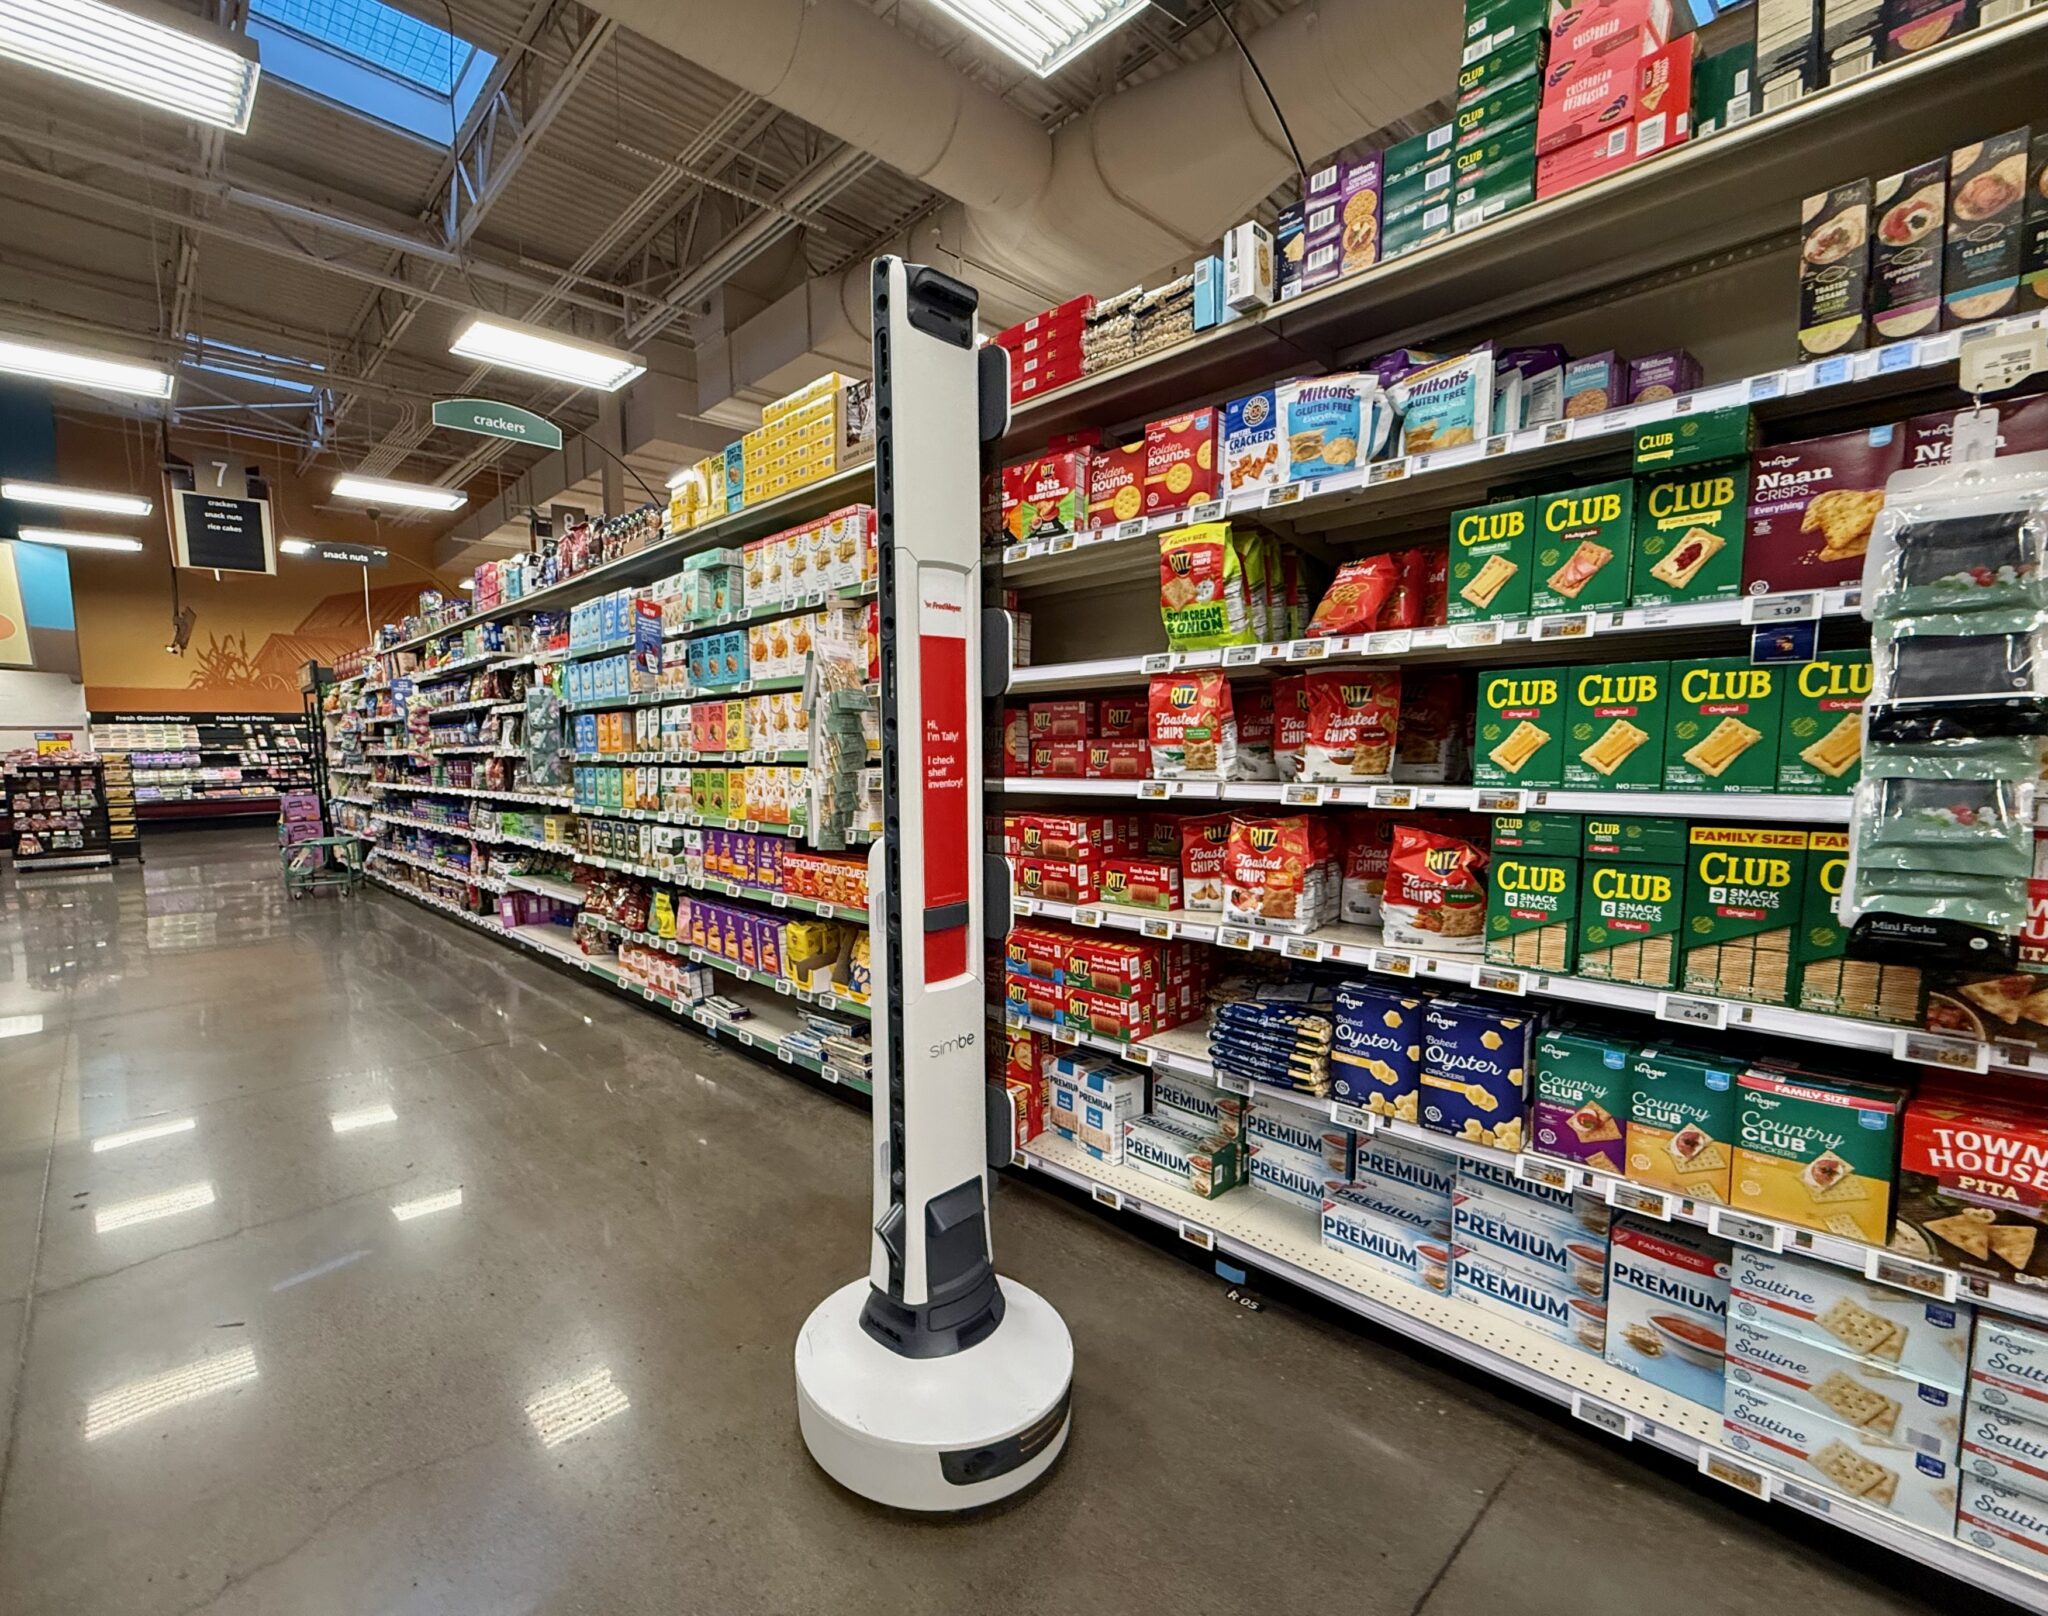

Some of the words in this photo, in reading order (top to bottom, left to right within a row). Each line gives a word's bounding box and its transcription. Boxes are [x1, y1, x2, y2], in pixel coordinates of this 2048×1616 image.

[1460, 65, 1484, 86] CLUB
[1459, 107, 1484, 128] CLUB
[1457, 149, 1483, 169] CLUB
[1962, 239, 2006, 258] CLASSIC
[1407, 369, 1470, 400] Milton's
[1444, 386, 1467, 400] FREE
[1297, 384, 1356, 405] Milton's
[1295, 402, 1330, 417] GLUTEN
[1332, 402, 1352, 413] FREE
[473, 414, 526, 434] crackers
[1229, 429, 1276, 451] CRACKERS
[1148, 442, 1182, 458] Golden
[1148, 448, 1191, 467] ROUNDS
[212, 461, 228, 487] 7
[1092, 466, 1125, 482] Golden
[1092, 473, 1134, 493] ROUNDS
[1756, 467, 1833, 491] Naan
[1036, 479, 1059, 493] bits
[1755, 483, 1809, 502] CRISPS
[208, 500, 237, 509] crackers
[1648, 476, 1735, 518] CLUB
[204, 511, 225, 520] snack
[226, 514, 243, 522] nuts
[1545, 494, 1622, 532] CLUB
[1754, 500, 1804, 516] Everything
[207, 523, 220, 531] rice
[222, 524, 242, 533] cakes
[1457, 510, 1525, 547] CLUB
[323, 549, 347, 560] snack
[348, 552, 368, 563] nuts
[1167, 611, 1190, 622] SOUR
[1190, 607, 1221, 619] CREAM
[1774, 606, 1801, 616] 3.99
[1167, 623, 1175, 634] &
[1176, 618, 1223, 633] ONION
[1563, 625, 1581, 633] 2.49
[1340, 685, 1374, 704] RITZ
[1486, 678, 1558, 708] CLUB
[1578, 674, 1658, 706] CLUB
[1681, 669, 1772, 703] CLUB
[1170, 686, 1198, 706] RITZ
[1709, 705, 1739, 714] Original
[927, 720, 938, 731] Hi,
[1156, 712, 1200, 726] Toasted
[1330, 712, 1378, 727] Toasted
[928, 732, 940, 741] I'm
[942, 732, 959, 743] Tally!
[1157, 727, 1184, 740] CHIPS
[1324, 729, 1357, 743] CHIPS
[932, 756, 955, 765] check
[928, 767, 946, 776] shelf
[928, 777, 963, 789] inventory!
[1495, 816, 1523, 829] CLUB
[1250, 827, 1278, 848] RITZ
[1694, 831, 1757, 843] FAMILY
[1761, 834, 1803, 845] SIZE
[822, 862, 845, 875] QUEST
[1190, 861, 1220, 873] CHIPS
[1236, 853, 1282, 870] Toasted
[1424, 848, 1460, 876] RITZ
[1700, 852, 1791, 887] CLUB
[1106, 871, 1127, 889] RITZ
[1235, 868, 1266, 883] CHIPS
[1497, 861, 1566, 893] CLUB
[1593, 868, 1671, 902] CLUB
[1714, 890, 1723, 900] 9
[1730, 888, 1779, 900] SNACK
[1402, 888, 1441, 904] CHIPS
[1507, 895, 1516, 904] 6
[1520, 893, 1557, 904] SNACK
[1729, 897, 1779, 908] STACKS
[1519, 900, 1557, 911] STACKS
[1604, 904, 1612, 913] 6
[1618, 902, 1662, 914] SNACK
[1618, 910, 1662, 922] STACKS
[1871, 921, 1900, 931] Mini
[1903, 923, 1937, 935] Forks
[1009, 945, 1027, 963] RITZ
[1070, 957, 1089, 977] RITZ
[1009, 983, 1027, 1001] RITZ
[1070, 1000, 1089, 1018] RITZ
[1336, 993, 1364, 1010] Kroger
[1336, 1014, 1364, 1028] Baked
[1427, 1012, 1458, 1030] Kroger
[1684, 1010, 1709, 1021] 6.49
[930, 1033, 975, 1058] simbe
[1336, 1024, 1402, 1052] Oyster
[1426, 1035, 1459, 1049] Baked
[1336, 1044, 1370, 1057] CRACKERS
[1541, 1044, 1570, 1059] Kroger
[1940, 1050, 1969, 1063] 2.49
[1426, 1046, 1502, 1075] Oyster
[1425, 1067, 1466, 1082] CRACKERS
[1634, 1063, 1667, 1080] Kroger
[1539, 1070, 1608, 1099] Country
[1539, 1084, 1584, 1101] CLUB
[1079, 1091, 1112, 1111] PREMIUM
[1155, 1085, 1218, 1118] PREMIUM
[1744, 1091, 1782, 1110] Kroger
[1775, 1084, 1822, 1099] FAMILY
[1823, 1094, 1850, 1105] SIZE
[1632, 1091, 1711, 1121] Country
[1632, 1105, 1682, 1125] CLUB
[1247, 1114, 1322, 1152] PREMIUM
[1741, 1110, 1845, 1149] Country
[1741, 1127, 1806, 1152] CLUB
[1933, 1128, 2048, 1168] TOWN
[1126, 1137, 1191, 1174] PREMIUM
[1741, 1140, 1798, 1159] CRACKERS
[1250, 1157, 1325, 1199] PREMIUM
[1358, 1149, 1450, 1193] PREMIUM
[1958, 1175, 2020, 1200] PITA
[1324, 1215, 1417, 1266] PREMIUM
[1454, 1208, 1567, 1267] PREMIUM
[1738, 1228, 1763, 1242] 3.99
[1637, 1240, 1674, 1256] FAMILY
[1676, 1253, 1704, 1267] SIZE
[1741, 1254, 1775, 1271] Kroger
[1719, 1266, 1728, 1274] 6
[1228, 1290, 1240, 1301] R
[1454, 1261, 1569, 1321] PREMIUM
[1614, 1261, 1727, 1317] PREMIUM
[1740, 1270, 1815, 1304] Saltine
[1736, 1323, 1769, 1340] Kroger
[1735, 1338, 1809, 1374] Saltine
[1735, 1388, 1768, 1406] Kroger
[1734, 1404, 1807, 1443] Saltine
